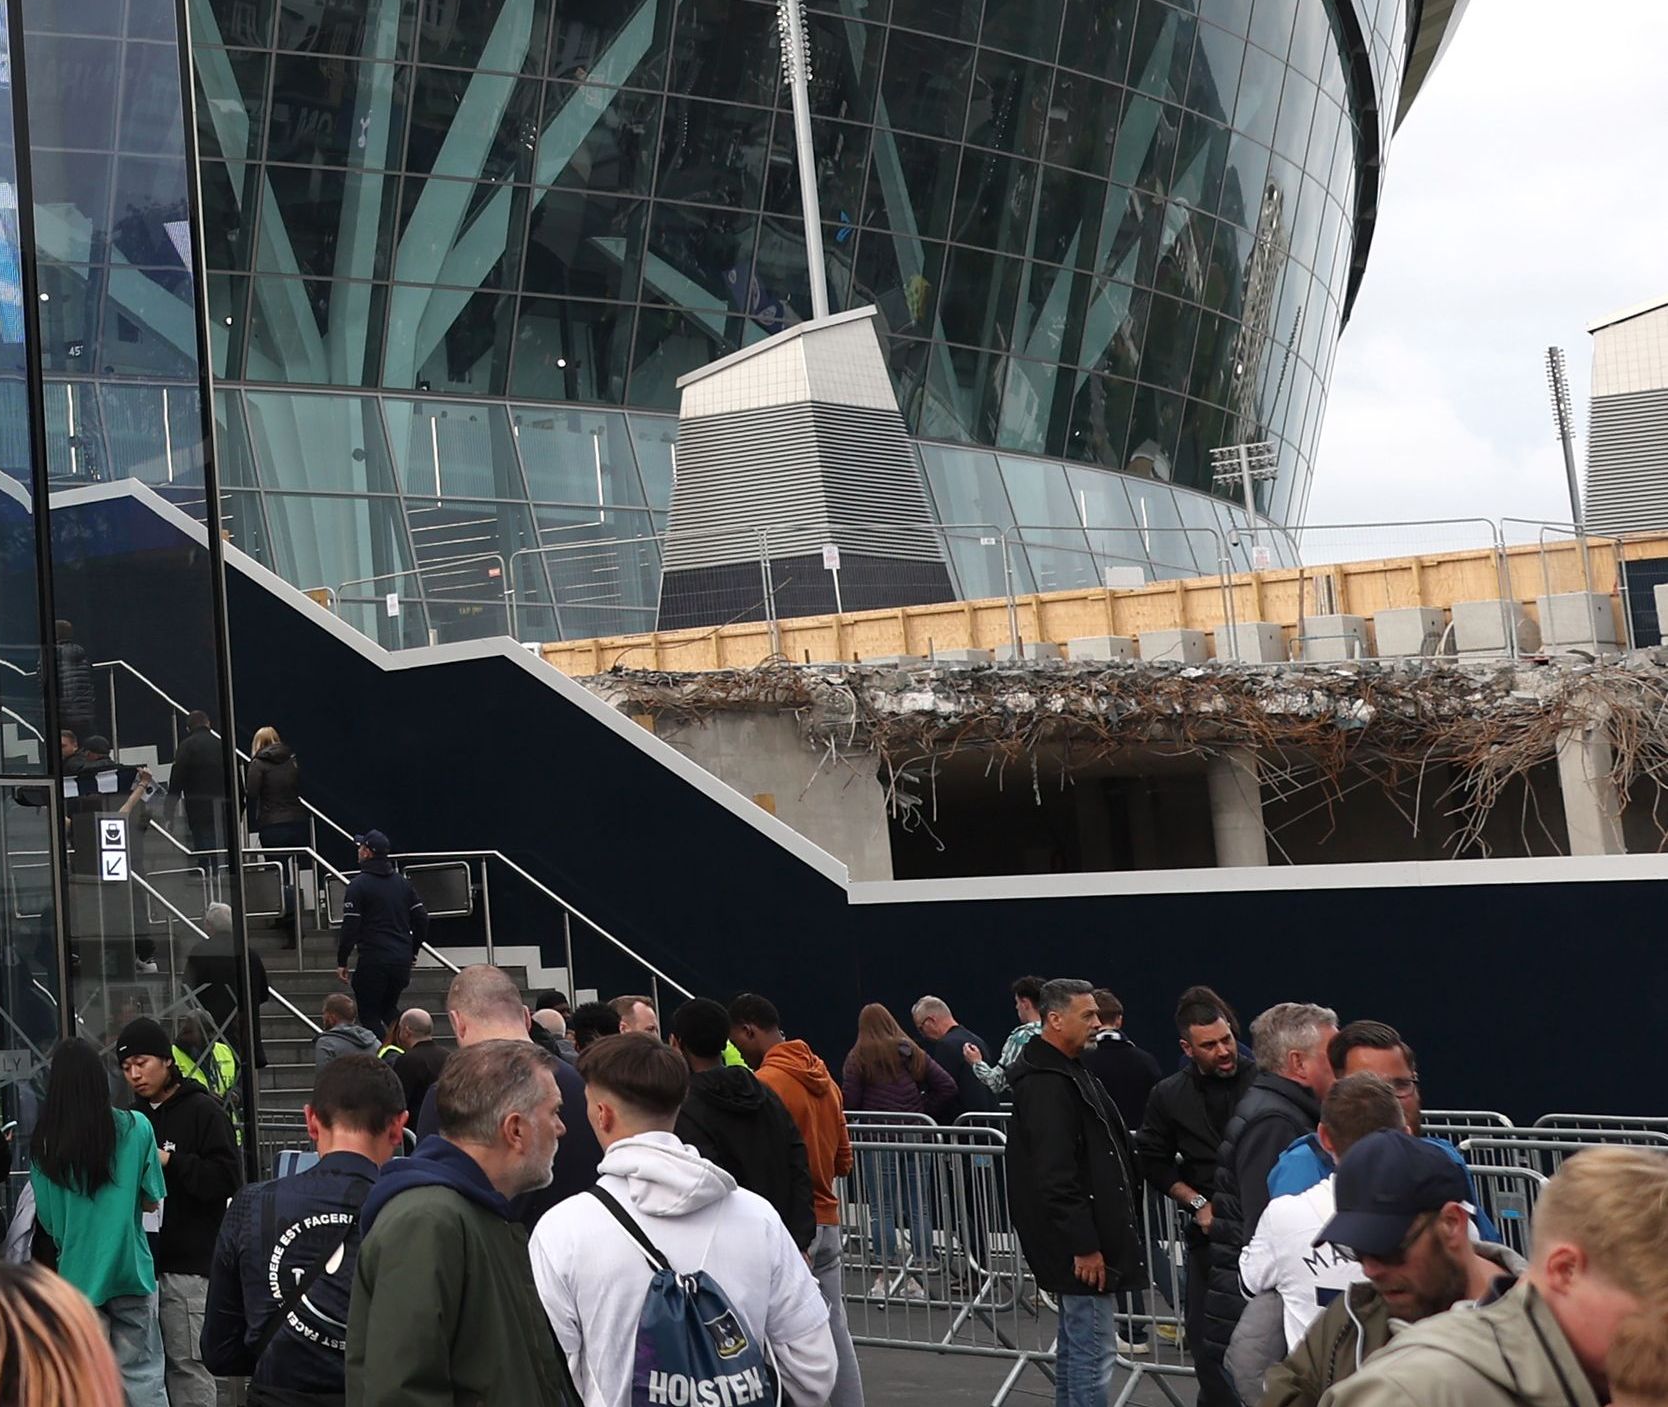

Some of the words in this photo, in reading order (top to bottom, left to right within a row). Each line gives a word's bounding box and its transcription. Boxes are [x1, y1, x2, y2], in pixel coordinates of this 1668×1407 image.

[269, 1245, 285, 1299] AUDERE
[280, 1223, 303, 1247] EST
[286, 1310, 320, 1343] FACE
[648, 1366, 764, 1407] HOLSTEN
